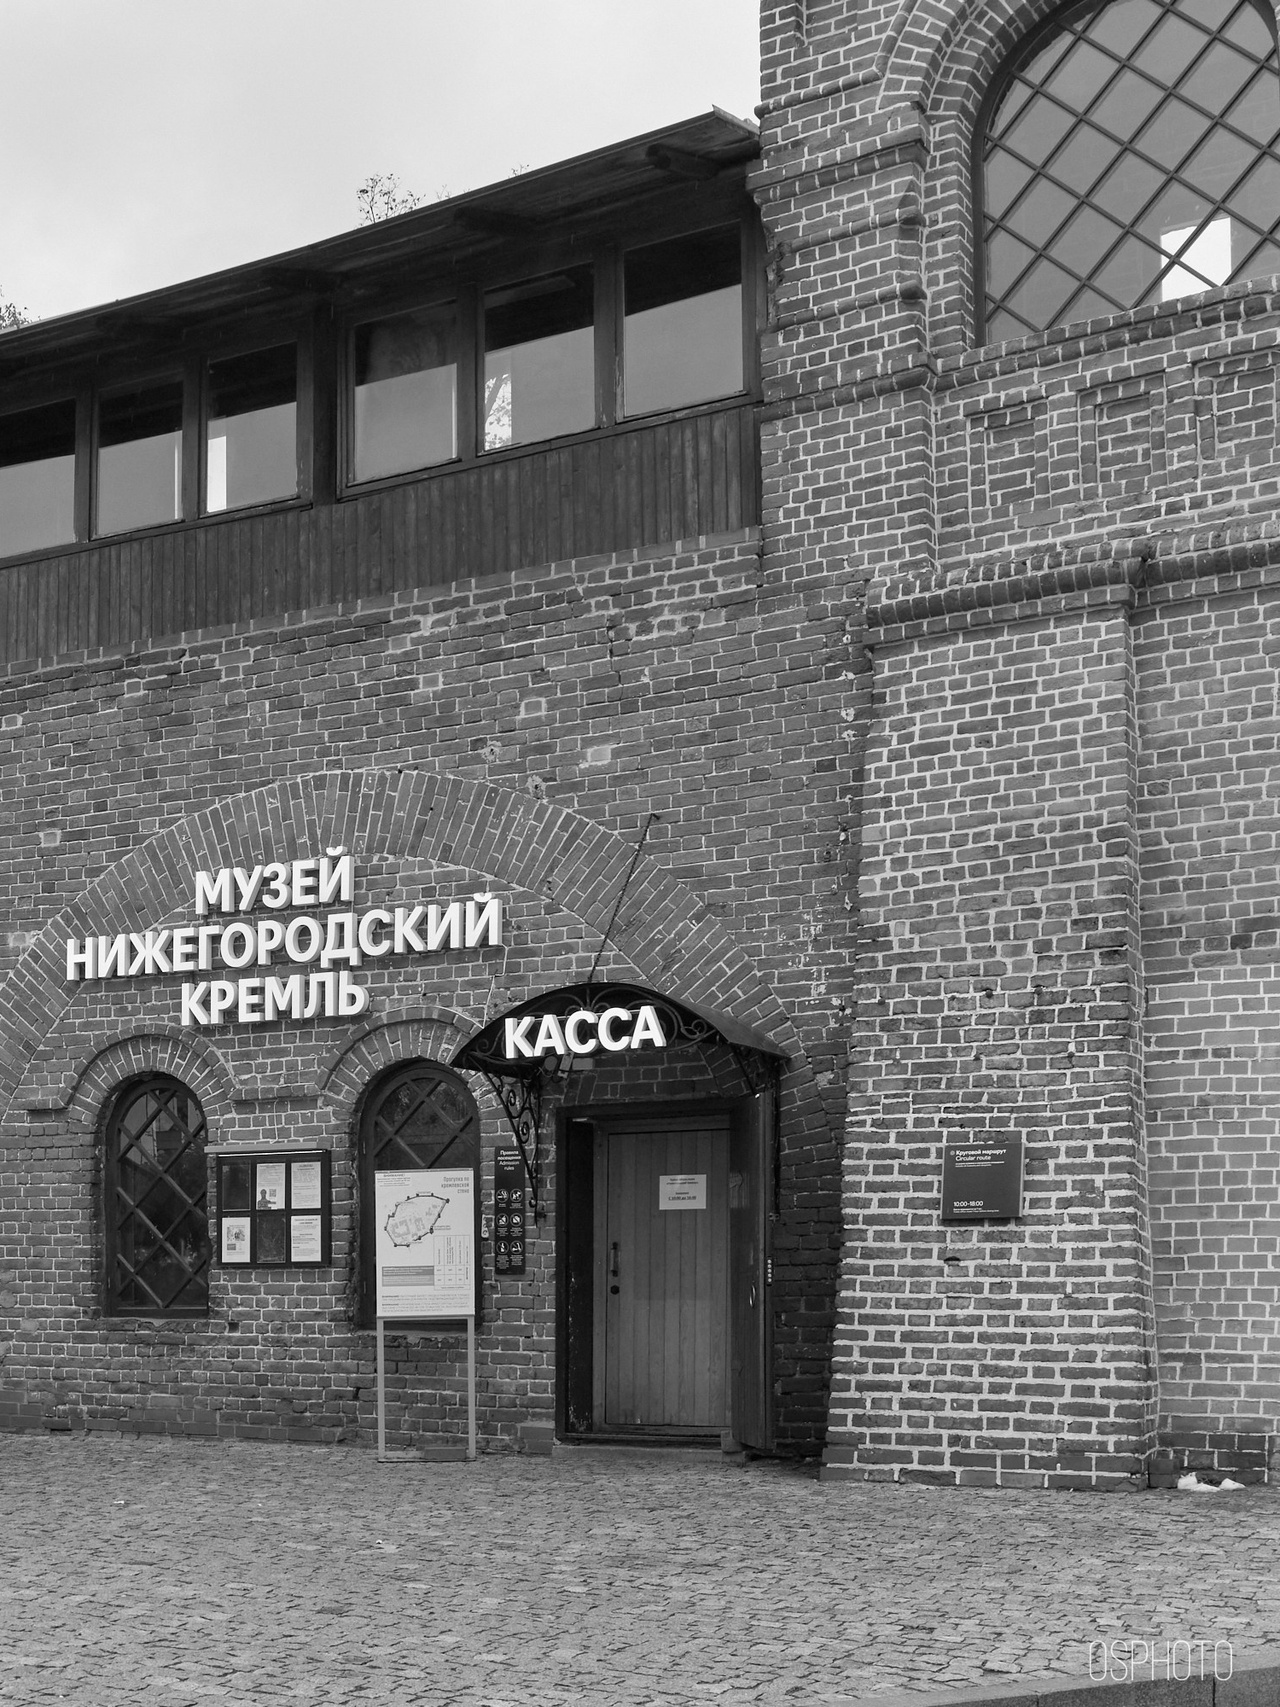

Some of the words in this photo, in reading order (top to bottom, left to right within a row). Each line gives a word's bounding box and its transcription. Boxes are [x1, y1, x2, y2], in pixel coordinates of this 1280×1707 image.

[195, 846, 355, 916] МУЗЕЙ
[67, 892, 503, 981] НИЖЕГОРОДСКИЙ
[181, 970, 370, 1026] КРЕМЛЬ
[504, 1005, 667, 1059] КАССА
[955, 1149, 982, 1157] Круговой
